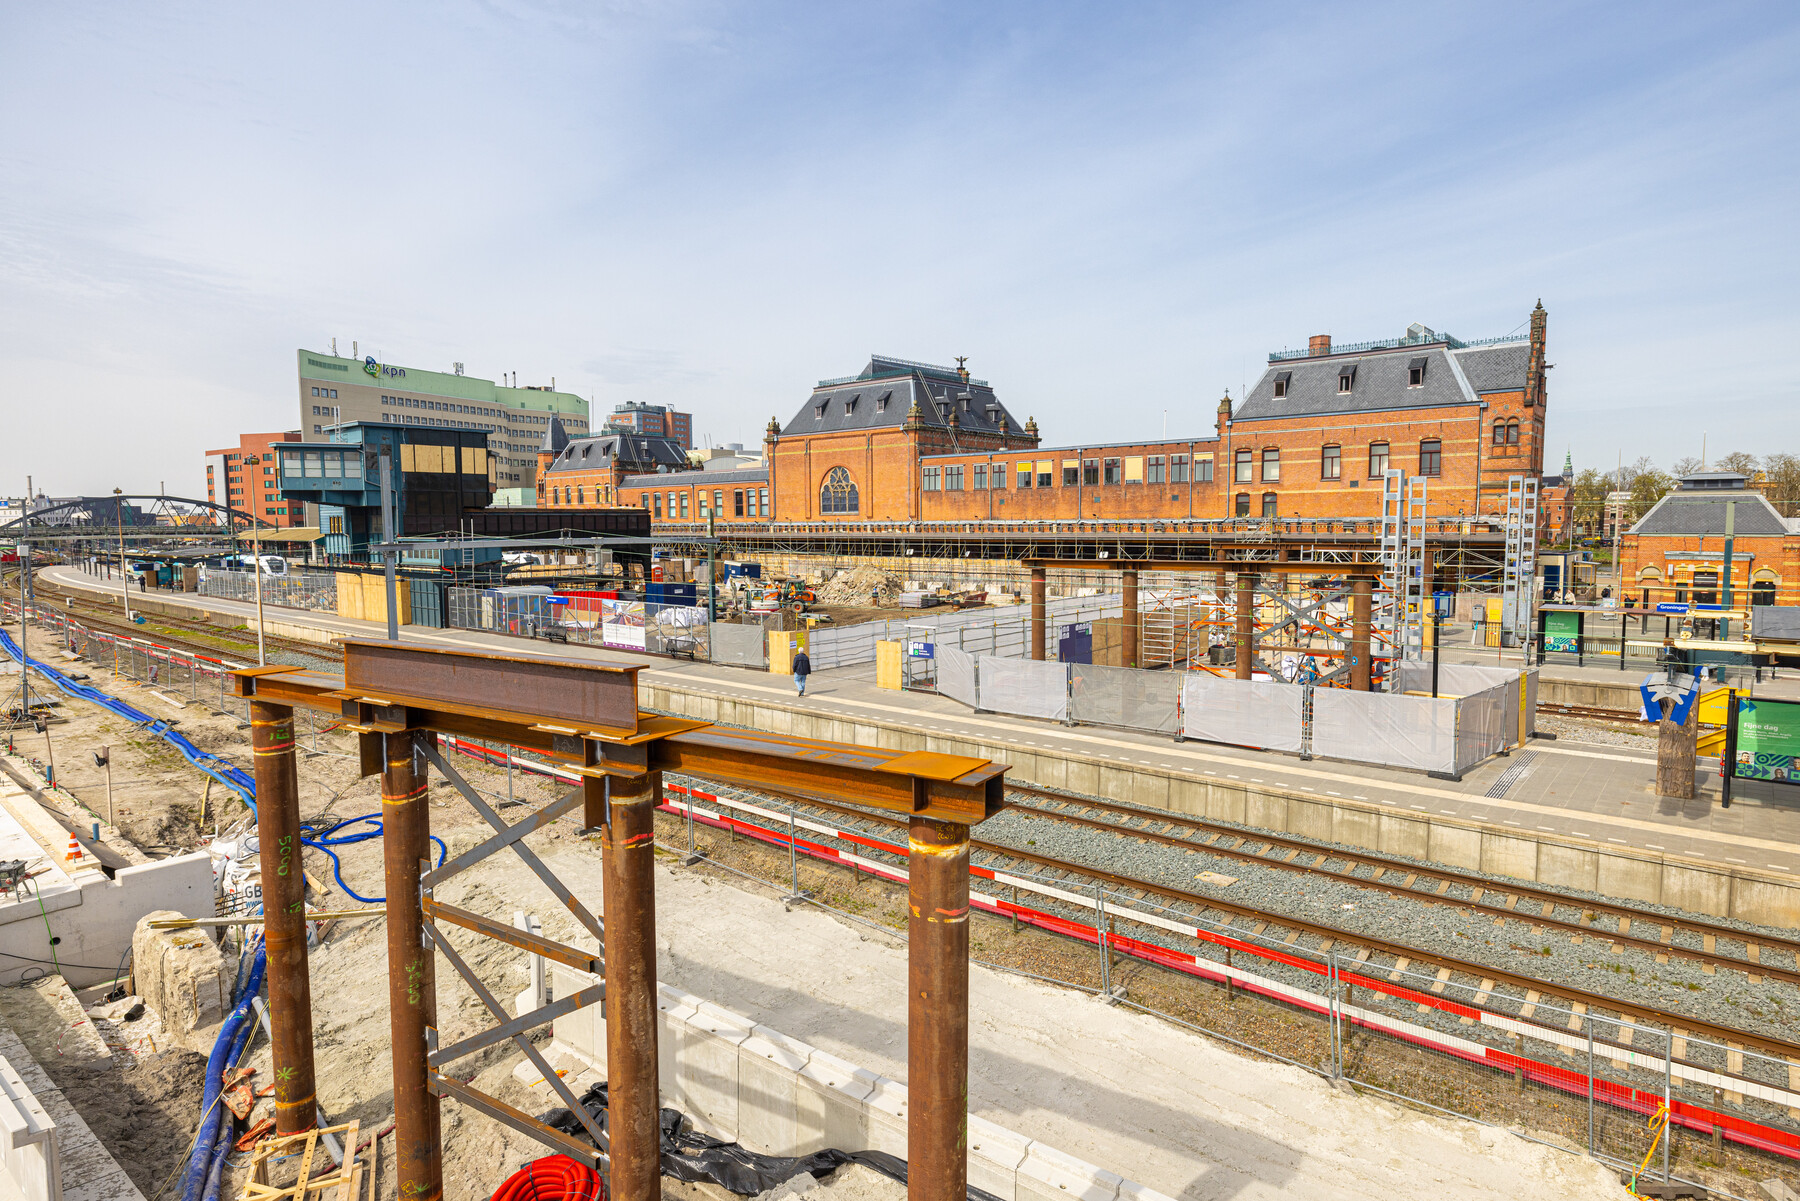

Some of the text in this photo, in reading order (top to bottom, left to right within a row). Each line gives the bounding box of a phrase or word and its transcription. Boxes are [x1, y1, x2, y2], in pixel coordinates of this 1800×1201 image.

[382, 363, 406, 378] kpn
[1743, 722, 1779, 732] Fijne dag
[278, 835, 292, 876] 5000
